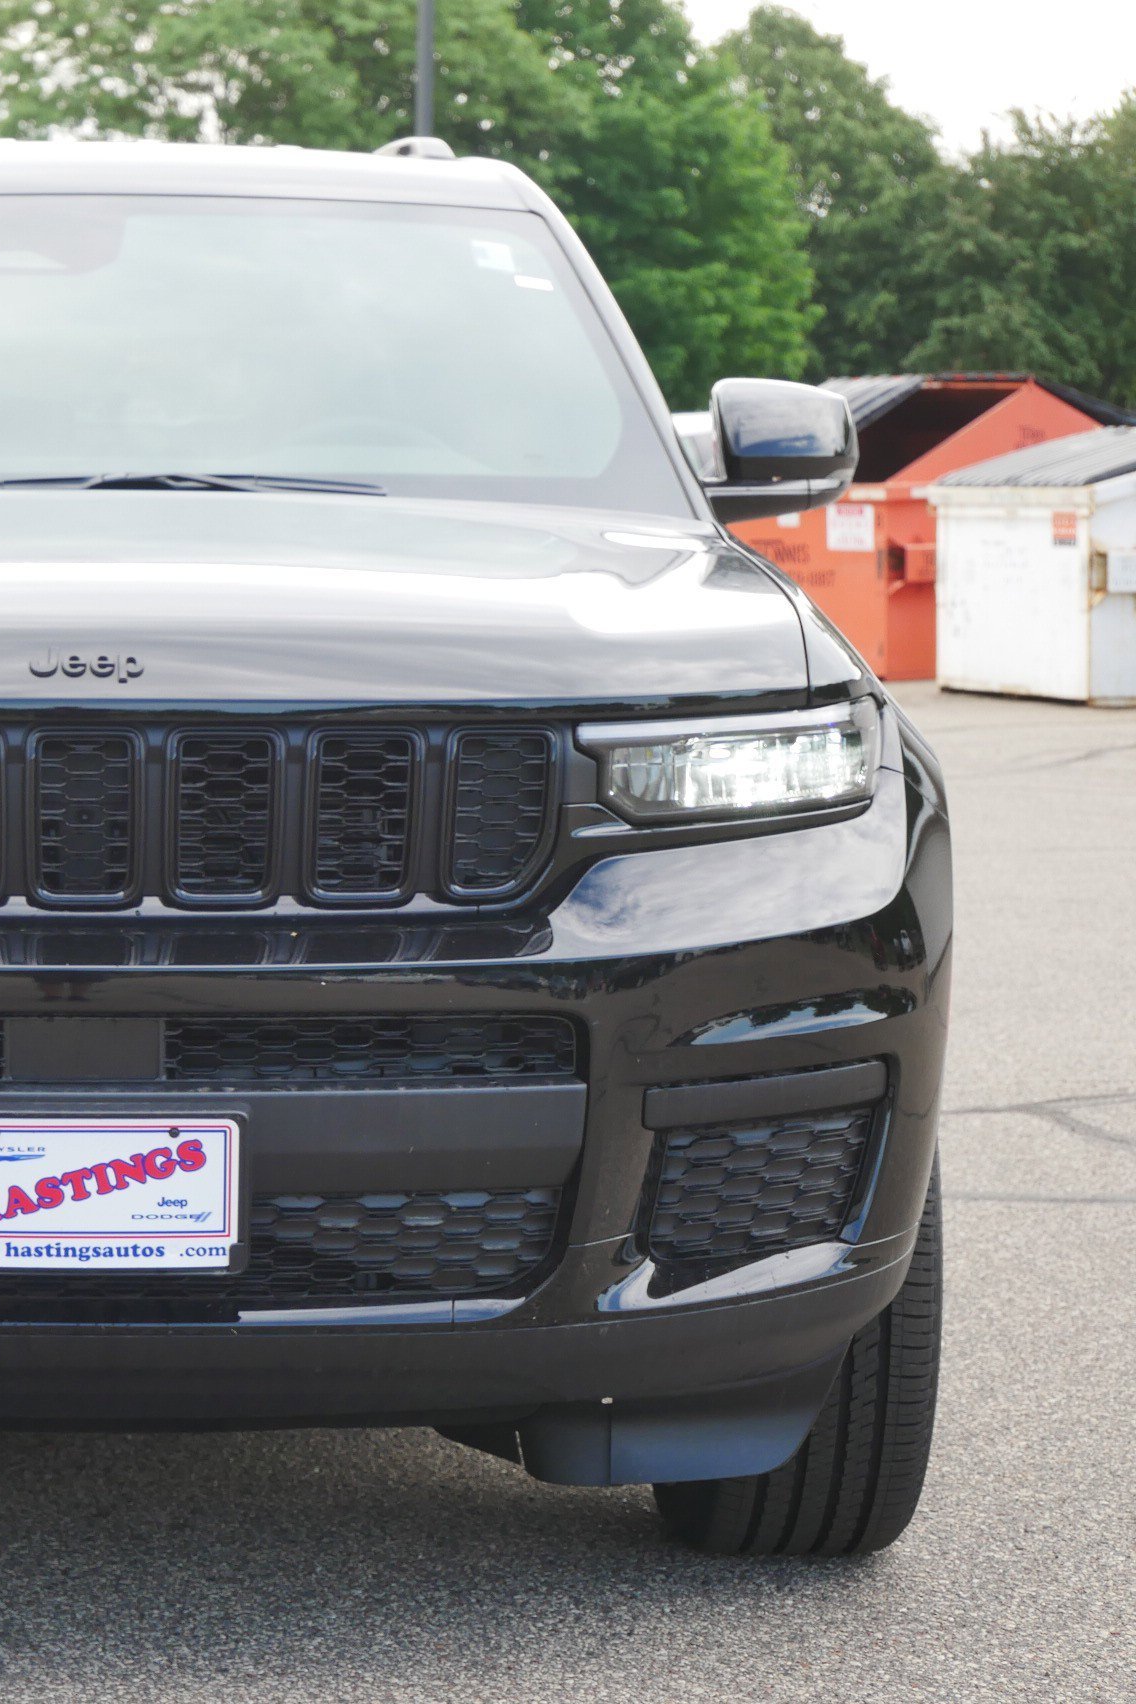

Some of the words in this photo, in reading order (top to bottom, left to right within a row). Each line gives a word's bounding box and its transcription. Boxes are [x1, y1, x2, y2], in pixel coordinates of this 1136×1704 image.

[29, 644, 144, 684] Jeep
[157, 1197, 188, 1208] Jeep
[131, 1213, 202, 1221] DODGE
[5, 1243, 165, 1261] hastingsautos
